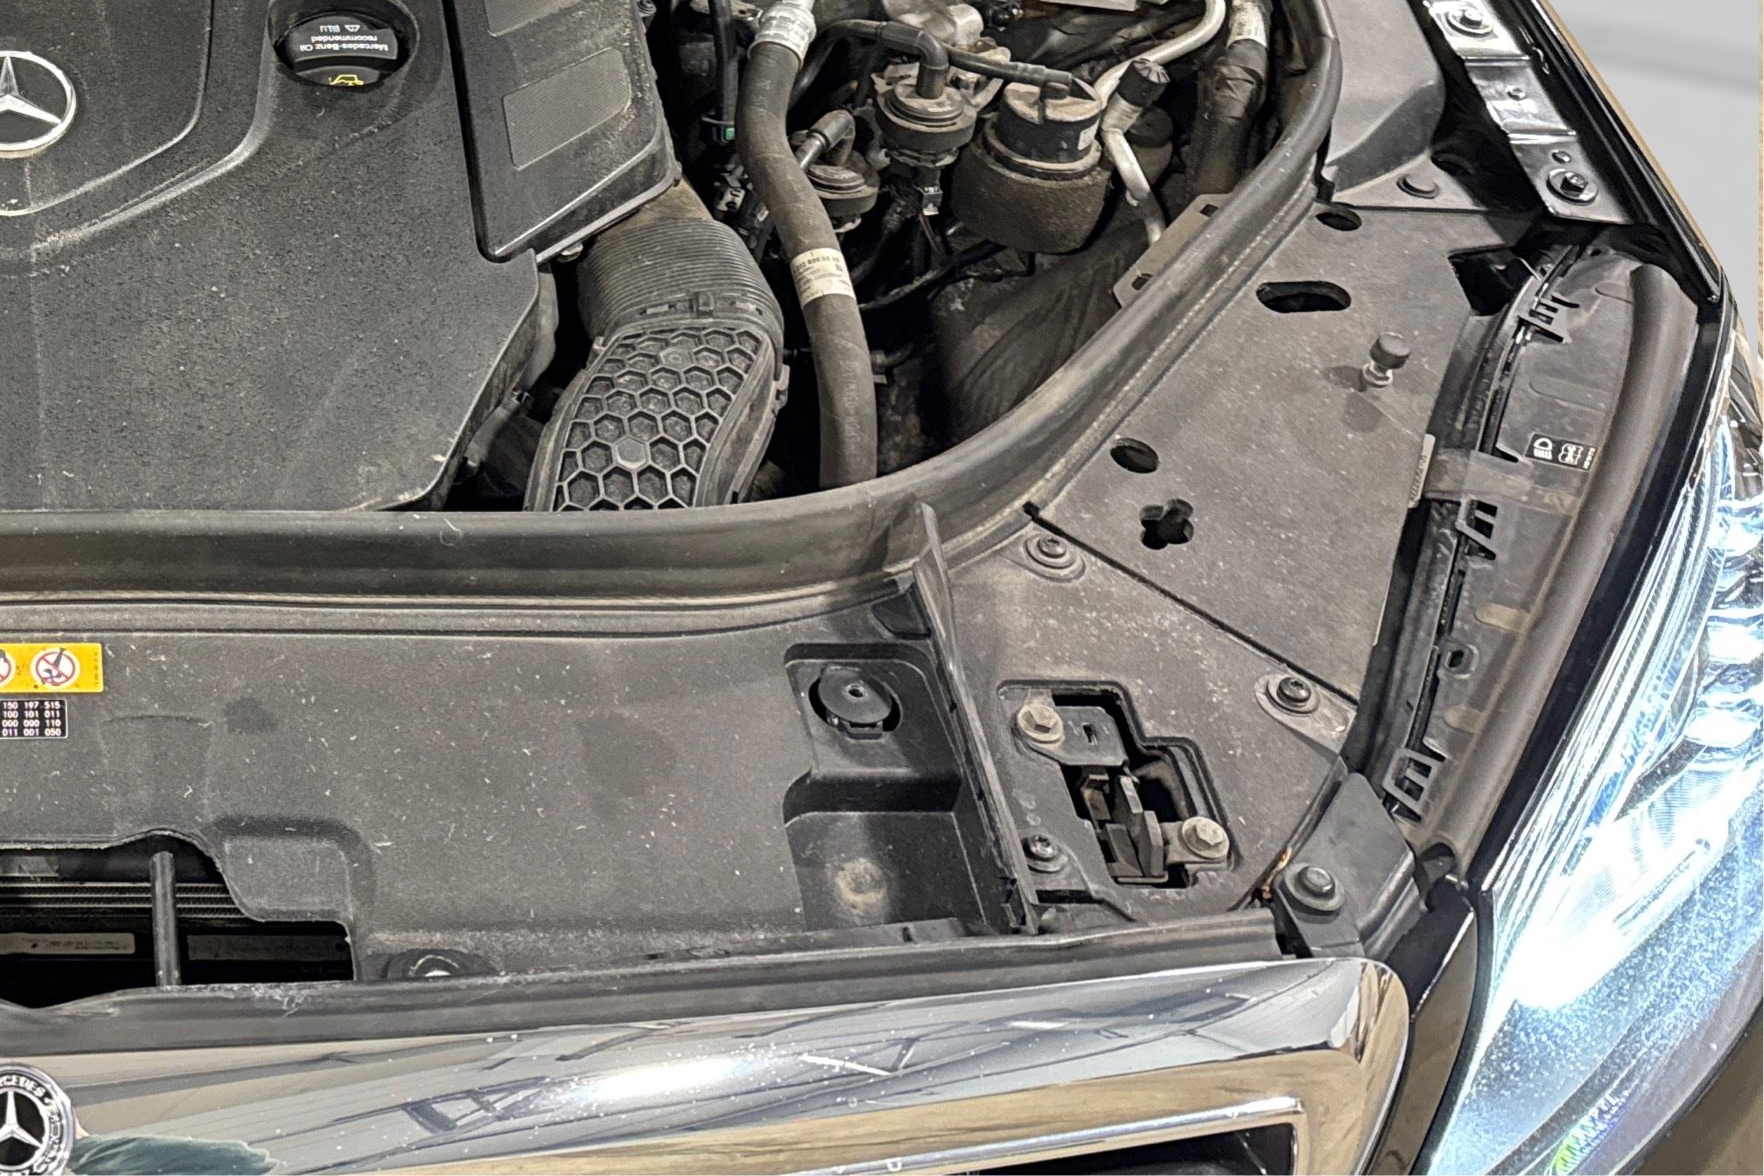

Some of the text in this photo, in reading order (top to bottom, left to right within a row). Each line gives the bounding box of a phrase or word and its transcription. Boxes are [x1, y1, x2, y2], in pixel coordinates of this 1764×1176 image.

[311, 35, 378, 43] recommended
[300, 43, 389, 52] Mercedes-Benz Oil
[3, 701, 18, 709] 150
[24, 701, 39, 709] 197
[44, 701, 60, 709] 515
[3, 710, 18, 718] 100
[24, 710, 39, 718] 101
[44, 710, 60, 718] 011
[2, 719, 18, 727] 000
[23, 719, 40, 727] 000
[45, 719, 61, 727] 110
[2, 728, 18, 736] 011
[23, 728, 39, 736] 001
